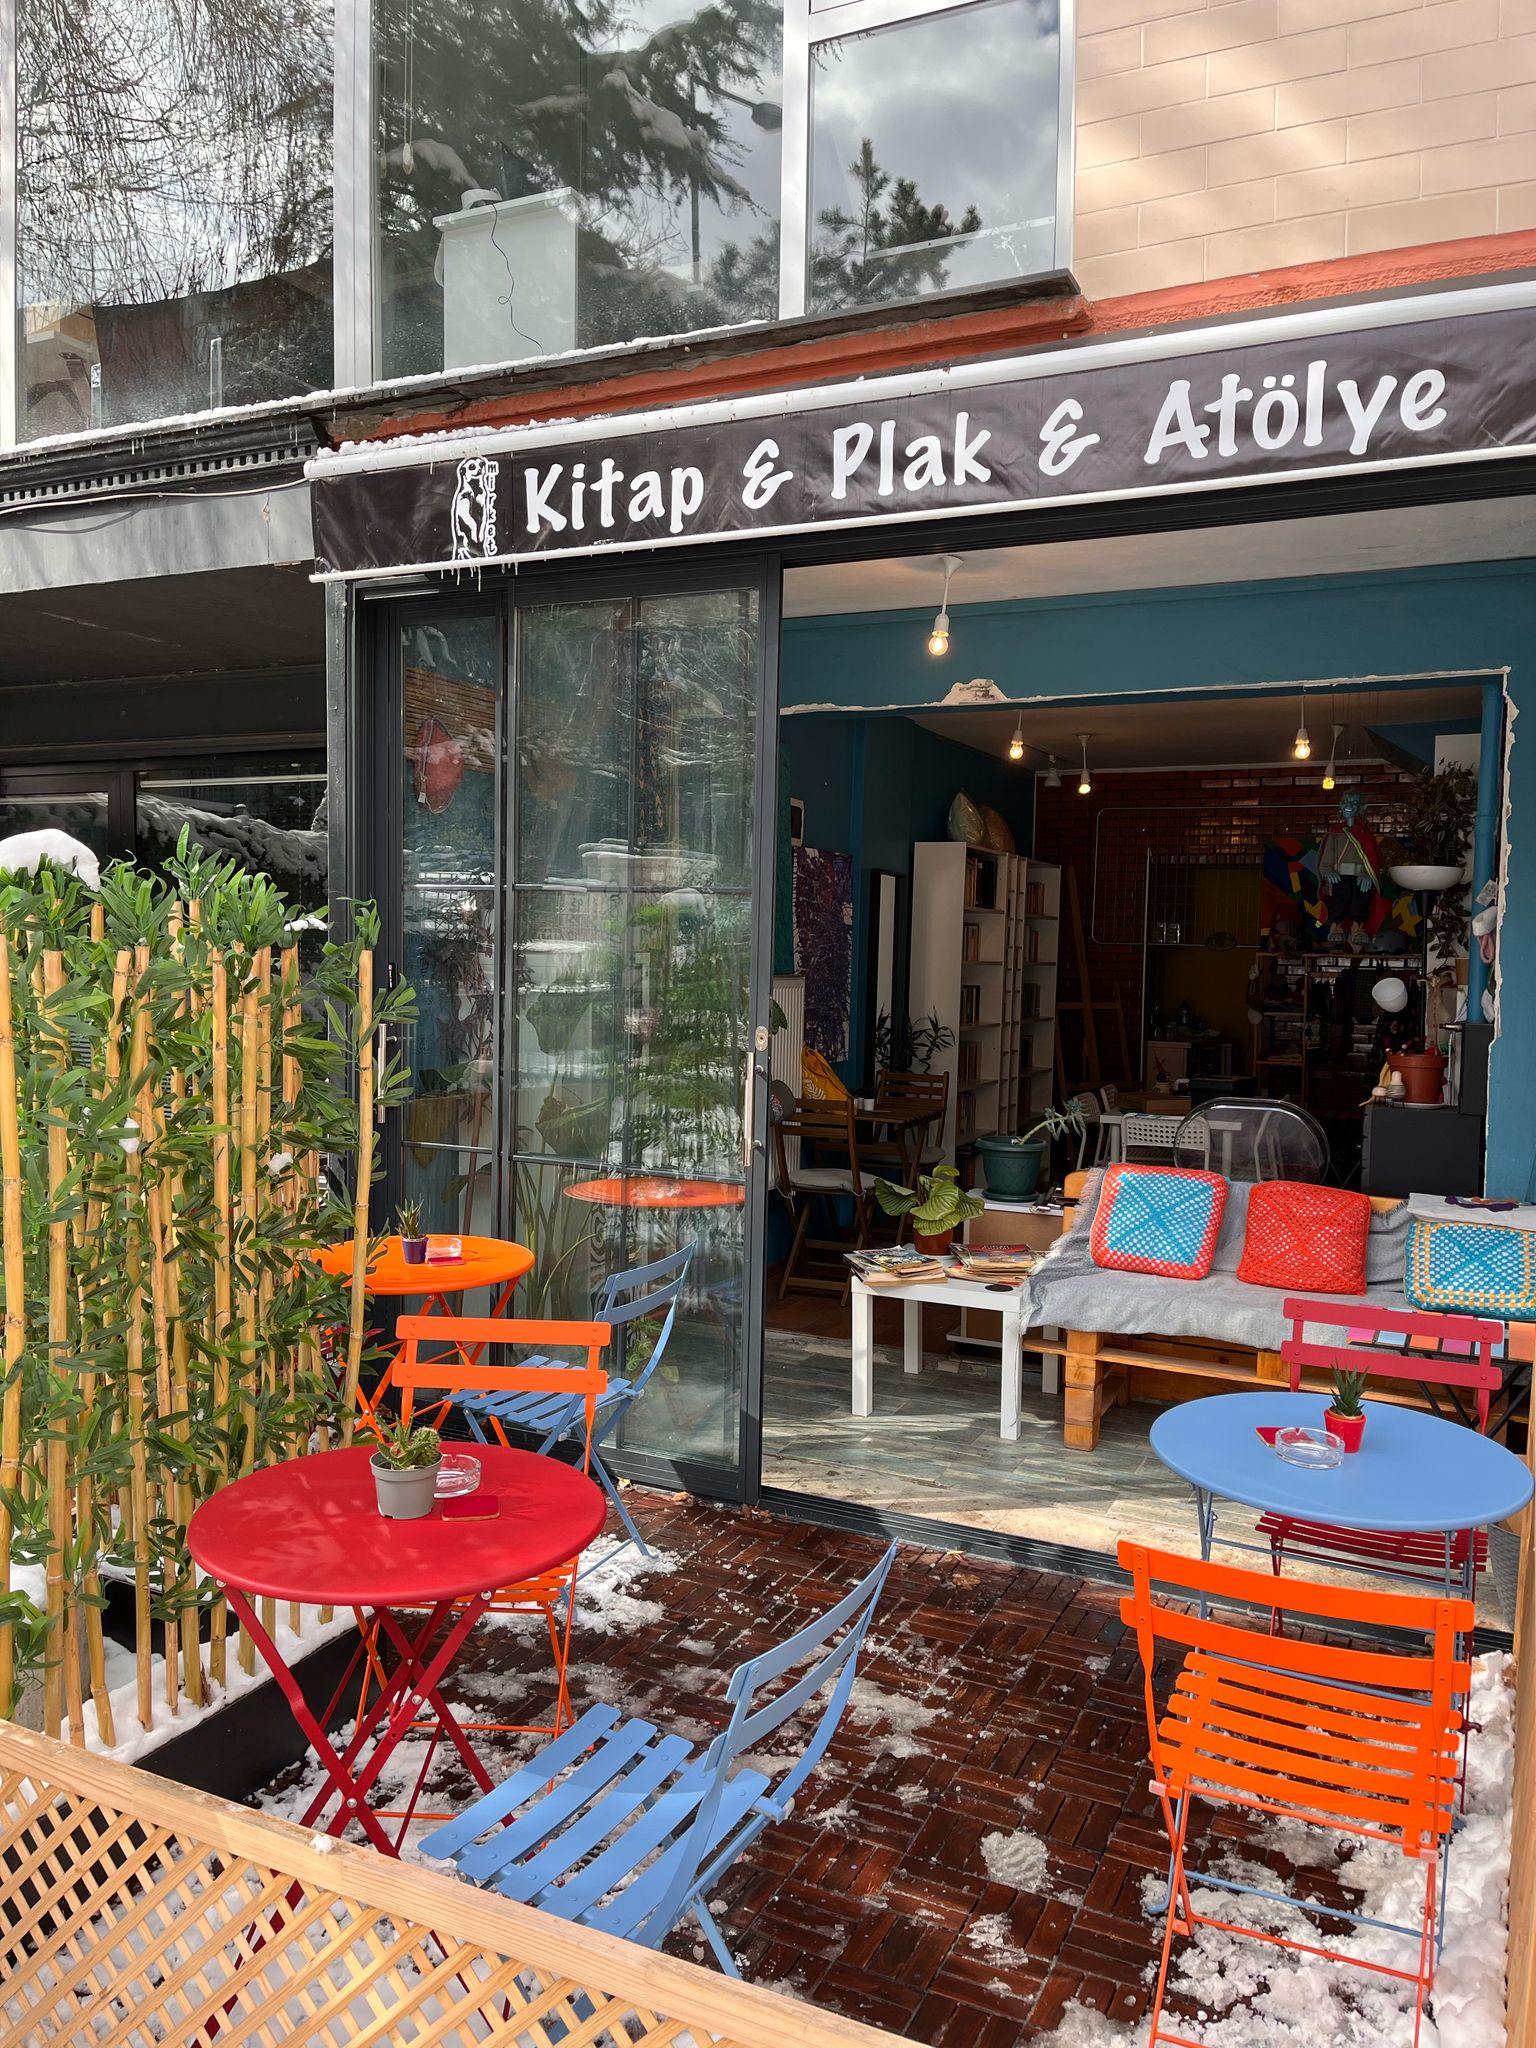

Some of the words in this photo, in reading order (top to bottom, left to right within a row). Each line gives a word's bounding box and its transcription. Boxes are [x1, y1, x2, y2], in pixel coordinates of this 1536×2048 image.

[486, 461, 498, 554] mirket
[524, 458, 704, 534] Kitap
[741, 438, 794, 510] &
[830, 411, 992, 500] Plak
[1038, 398, 1101, 477] &
[1143, 359, 1447, 465] Atölye
